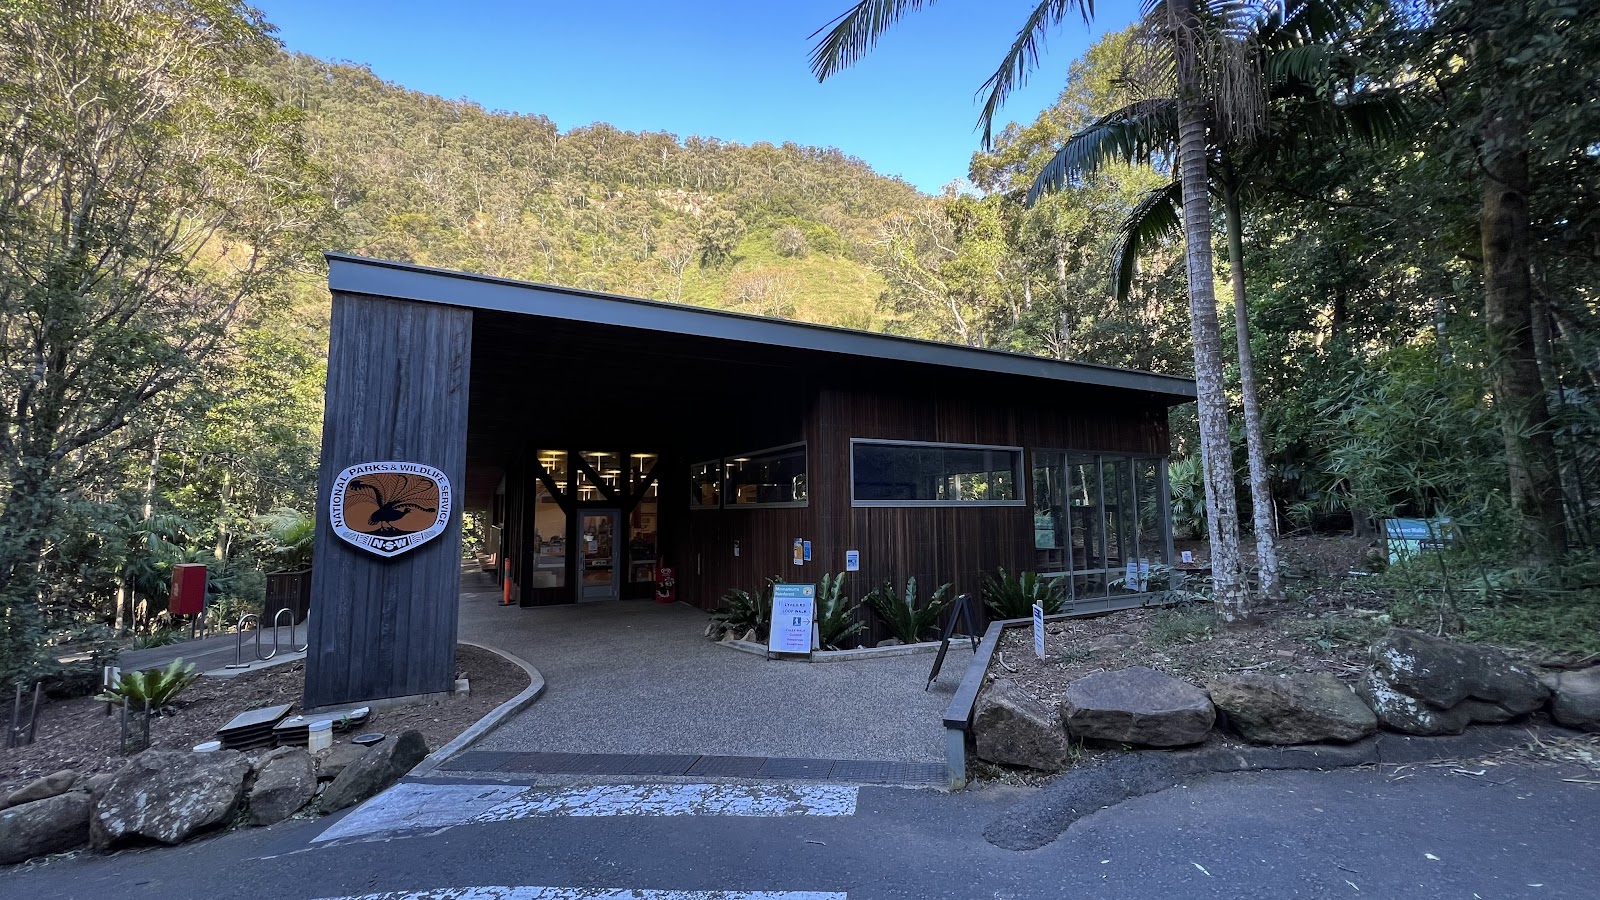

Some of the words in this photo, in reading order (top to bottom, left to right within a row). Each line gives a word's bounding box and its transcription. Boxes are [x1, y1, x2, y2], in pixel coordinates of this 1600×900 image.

[333, 476, 349, 528] NATIONAL
[349, 464, 389, 475] PARKS
[400, 464, 446, 484] WILDLIFE
[437, 485, 449, 526] SERVICE
